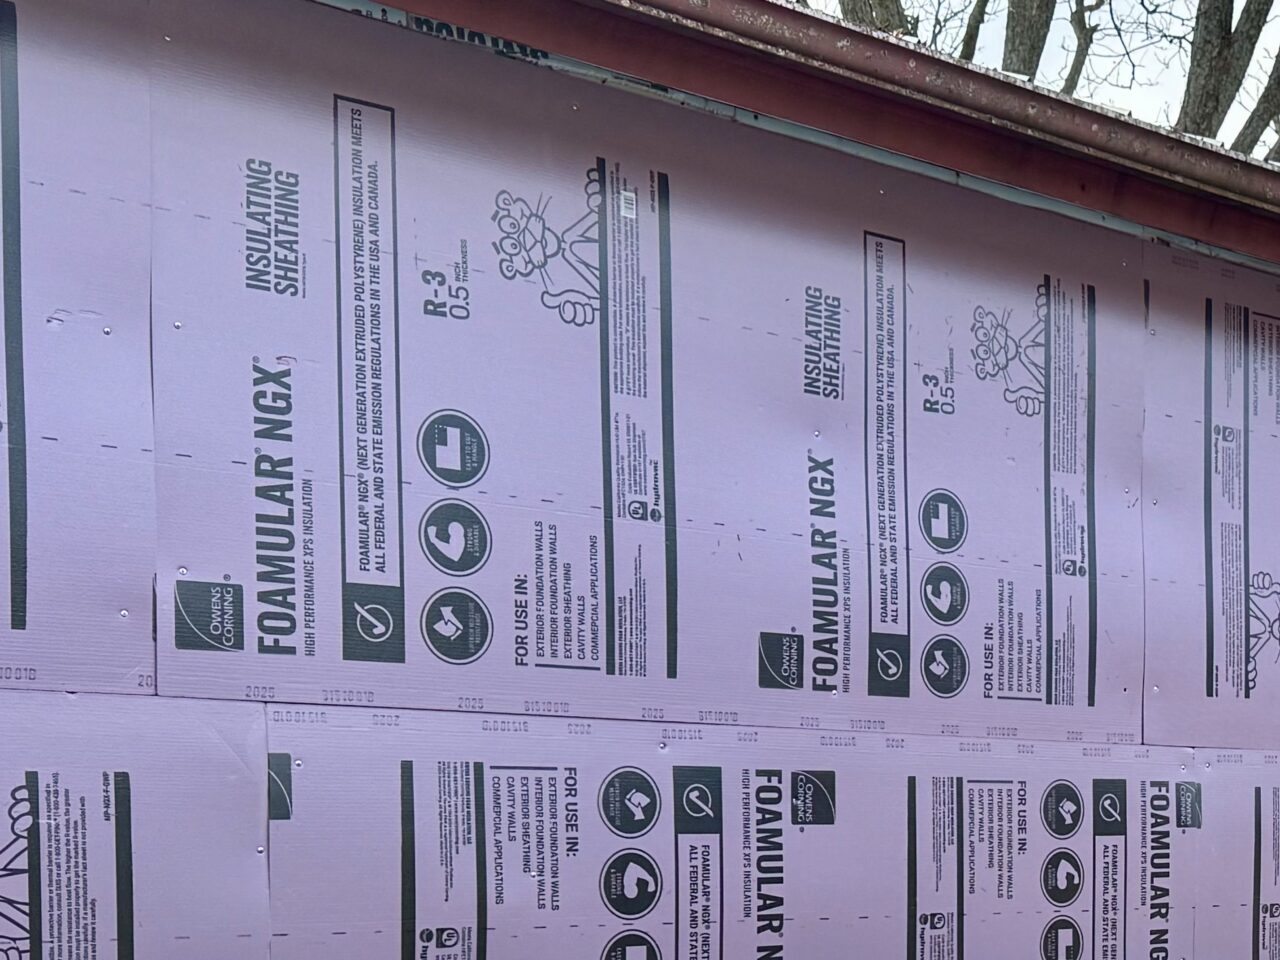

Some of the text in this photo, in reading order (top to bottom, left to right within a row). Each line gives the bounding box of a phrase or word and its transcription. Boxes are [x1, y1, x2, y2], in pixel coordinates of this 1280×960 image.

[350, 106, 364, 146] MEETS
[351, 147, 363, 216] INSULATION
[245, 158, 271, 291] INSULATING
[273, 170, 299, 295] SHEATHING
[352, 218, 365, 302] POLYSTYRENE)
[421, 269, 447, 317] R-3
[459, 238, 468, 282] THICKNESS
[354, 304, 366, 361] EXTRUDED
[447, 284, 470, 320] 0.5
[367, 160, 385, 573] ALL FEDERAL AND STATE EMISSION REGULATIONS IN THE USA AND CANADA.
[803, 285, 824, 395] INSULATING
[822, 295, 840, 398] SHEATHING
[355, 363, 367, 434] GENERATION
[921, 373, 941, 413] R-3
[939, 385, 955, 414] 0.5
[356, 436, 369, 470] (NEXT
[301, 478, 315, 656] HIGH PERFORMANCE XPS INSULATION
[534, 520, 544, 657] EXTERIOR FOUNDATION WALLS
[548, 523, 558, 658] INTERIOR FOUNDATION WALLS
[589, 534, 598, 599] APPLICATIONS
[209, 586, 222, 634] OWENS
[513, 573, 528, 666] FOR USE IN:
[562, 562, 572, 659] EXTERIOR SHEATHING
[576, 595, 585, 659] CAVITY WALLS
[841, 547, 851, 693] HIGH PERFORMANCE XPS INSULATION
[781, 636, 791, 678] OWENS
[983, 622, 993, 698] FOR USE IN:
[506, 776, 516, 842] CAVITY WALLS
[520, 776, 531, 875] EXTERIOR SHEATHING
[563, 766, 579, 857] FOR USE IN:
[804, 783, 813, 825] OWENS
[1017, 780, 1027, 855] FOR USE IN:
[493, 838, 504, 904] APPLICATIONS
[534, 776, 546, 909] INTERIOR FOUNDATION WALLS
[548, 776, 559, 911] EXTERIOR FOUNDATION WALLS
[688, 844, 698, 862] ALL
[741, 768, 751, 920] HIGH PERFORMANCE XPS INSULATION
[689, 864, 698, 906] FEDERAL
[689, 908, 698, 929] AND
[1139, 865, 1147, 906] INSULATION
[700, 932, 710, 960] (NEXT
